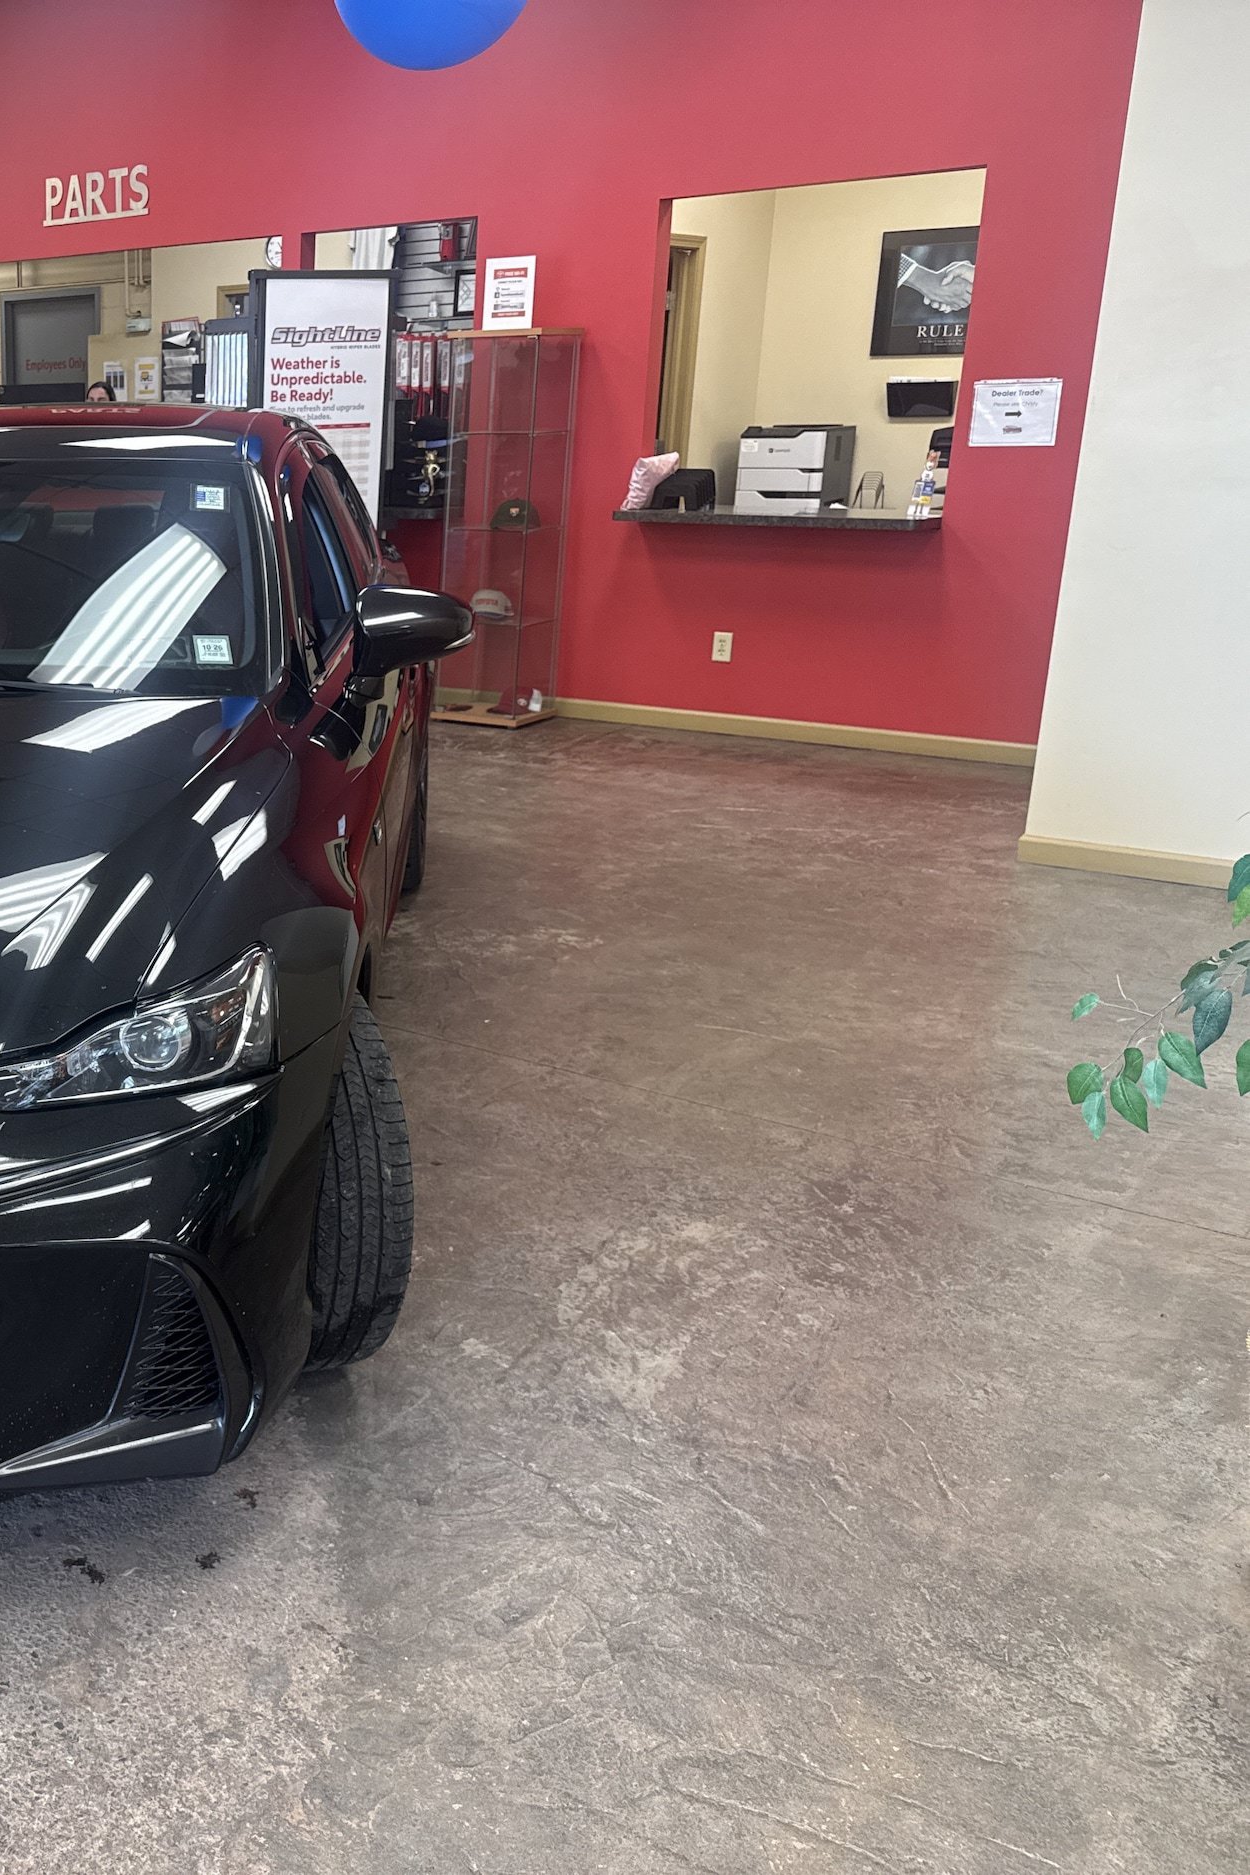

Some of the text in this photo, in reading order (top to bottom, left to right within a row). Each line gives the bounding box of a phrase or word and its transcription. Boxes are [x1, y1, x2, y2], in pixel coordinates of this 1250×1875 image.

[45, 164, 149, 222] PARTS
[271, 326, 381, 347] SightLine
[916, 324, 964, 338] RULE
[26, 357, 87, 373] Employees Only
[271, 356, 340, 370] Weather is
[271, 371, 367, 388] Unpredictable.
[270, 388, 334, 404] Be Ready!
[1018, 389, 1044, 397] Trade?
[296, 404, 321, 412] refresh
[336, 403, 365, 413] upgrade
